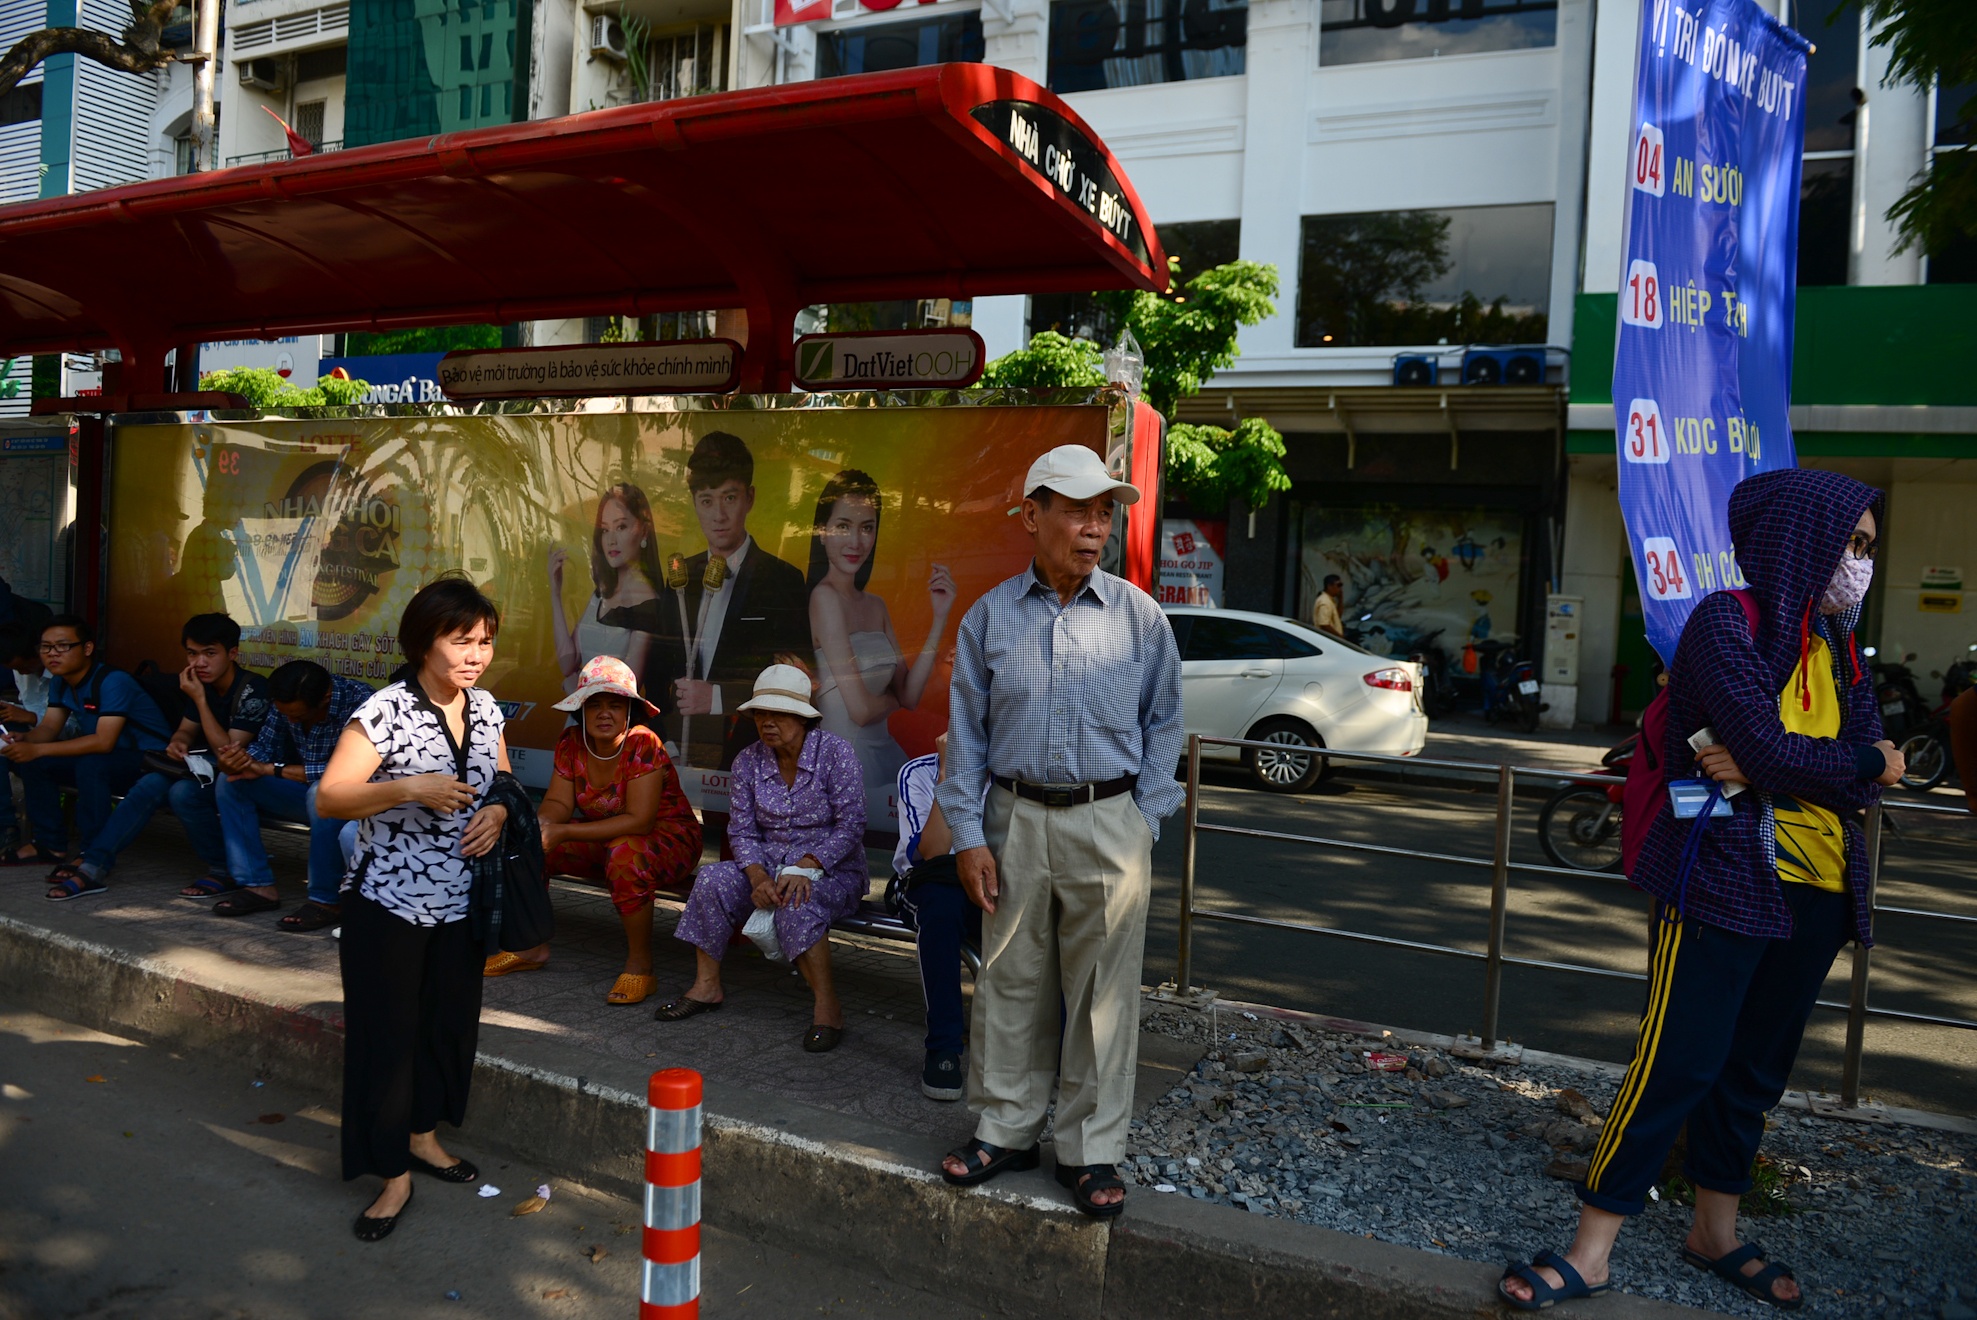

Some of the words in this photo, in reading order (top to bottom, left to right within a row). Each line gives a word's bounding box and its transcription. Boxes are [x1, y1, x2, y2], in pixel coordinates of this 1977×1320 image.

[1673, 8, 1703, 66] TRÍ
[1702, 23, 1741, 86] ĐÓN
[1737, 49, 1758, 99] XE
[1009, 109, 1039, 166] NHÀ
[1045, 143, 1076, 193] CHỜ
[1078, 172, 1098, 214] XE
[1099, 190, 1132, 240] BÚYT
[1636, 136, 1663, 190] 04
[1672, 156, 1694, 198] AN
[1630, 273, 1657, 322] 18
[1669, 279, 1712, 333] HIỆP
[442, 366, 467, 385] Bảo
[469, 365, 482, 386] vệ
[484, 364, 506, 381] môi
[507, 363, 546, 384] trường
[547, 361, 558, 378] là
[560, 360, 583, 378] bảo
[584, 359, 599, 381] vệ
[600, 358, 622, 377] sức
[623, 357, 656, 376] khỏe
[657, 356, 693, 375] chính
[695, 355, 730, 375] mình
[1629, 412, 1660, 458] 31
[1674, 417, 1718, 455] KDC
[355, 525, 401, 566] CA
[1159, 560, 1179, 569] HOI
[1181, 560, 1196, 570] GO
[1198, 561, 1214, 570] JIP
[1646, 550, 1684, 596] 34
[1693, 552, 1717, 590] ĐH
[299, 628, 313, 648] ĂN
[315, 629, 349, 650] KHÁCH
[351, 631, 372, 653] GÂY
[375, 631, 395, 654] SỐT
[335, 654, 363, 677] TIẾNG
[366, 657, 387, 679] CỦA
